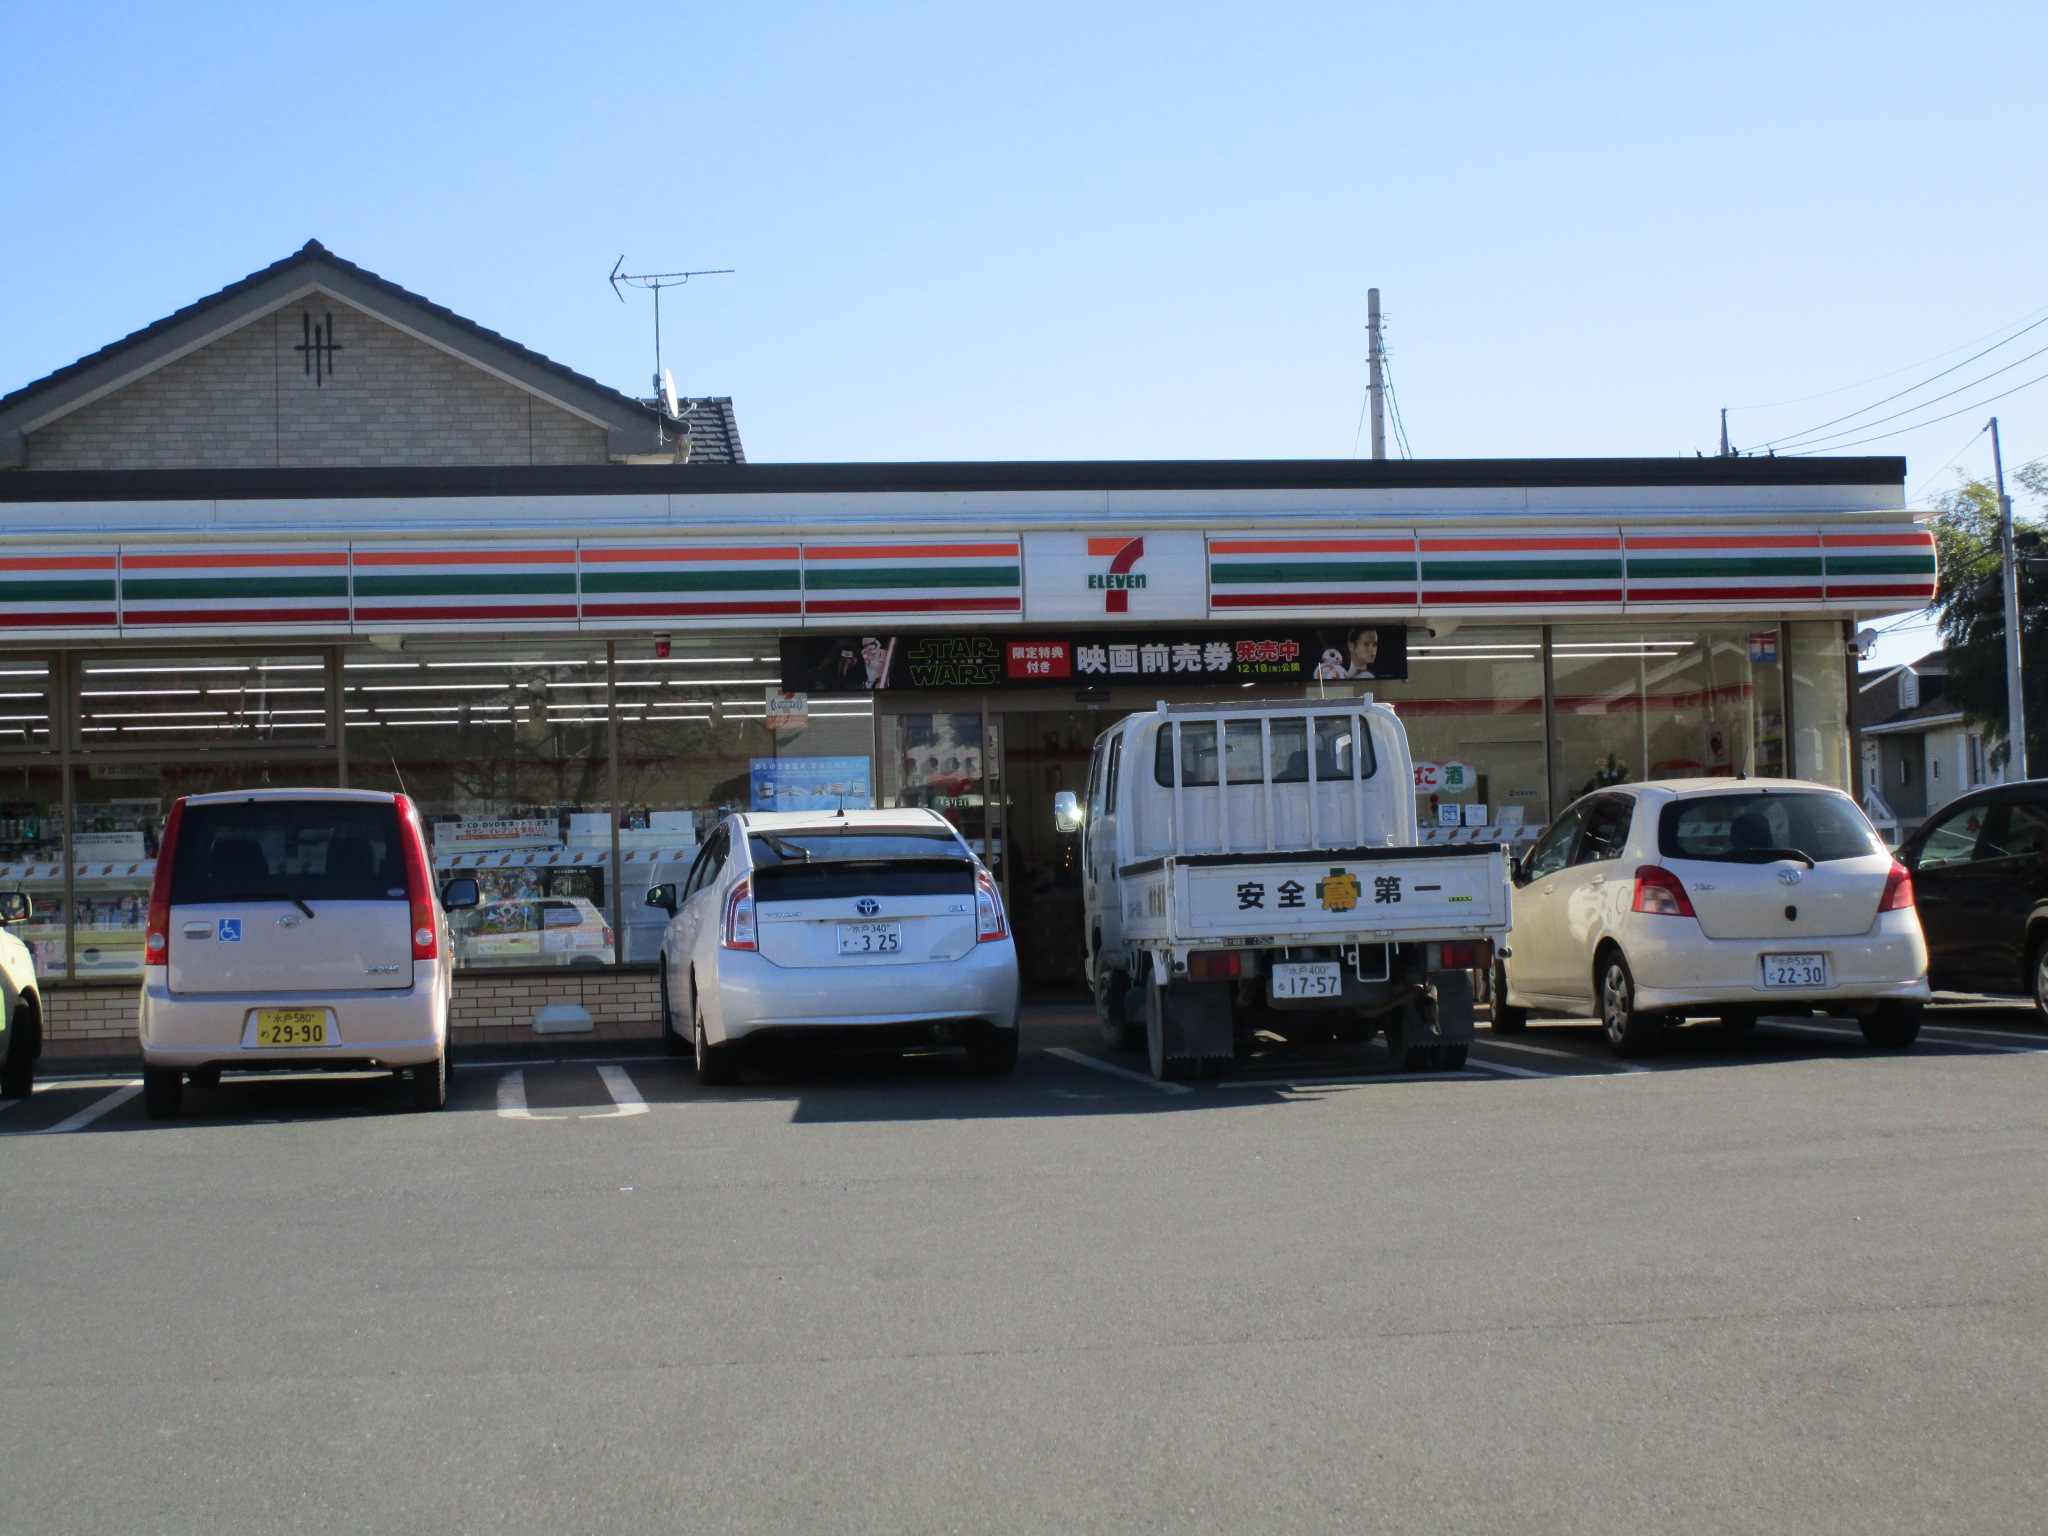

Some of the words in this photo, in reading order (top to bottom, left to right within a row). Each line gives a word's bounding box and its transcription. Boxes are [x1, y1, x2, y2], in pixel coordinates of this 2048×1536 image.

[908, 638, 999, 658] STAR
[1012, 646, 1064, 660] 限定特典
[1076, 642, 1233, 674] 映画前売券
[1235, 639, 1299, 662] 発売中
[909, 665, 1000, 686] WARS
[1026, 661, 1051, 674] 付き
[1413, 766, 1437, 786] ばこ
[1445, 765, 1464, 785] 酒
[1237, 879, 1306, 910] 安全
[1374, 876, 1441, 904] 第一
[1291, 976, 1338, 995] 17-57
[1777, 967, 1822, 984] 22-30
[272, 1025, 323, 1044] 29-90
